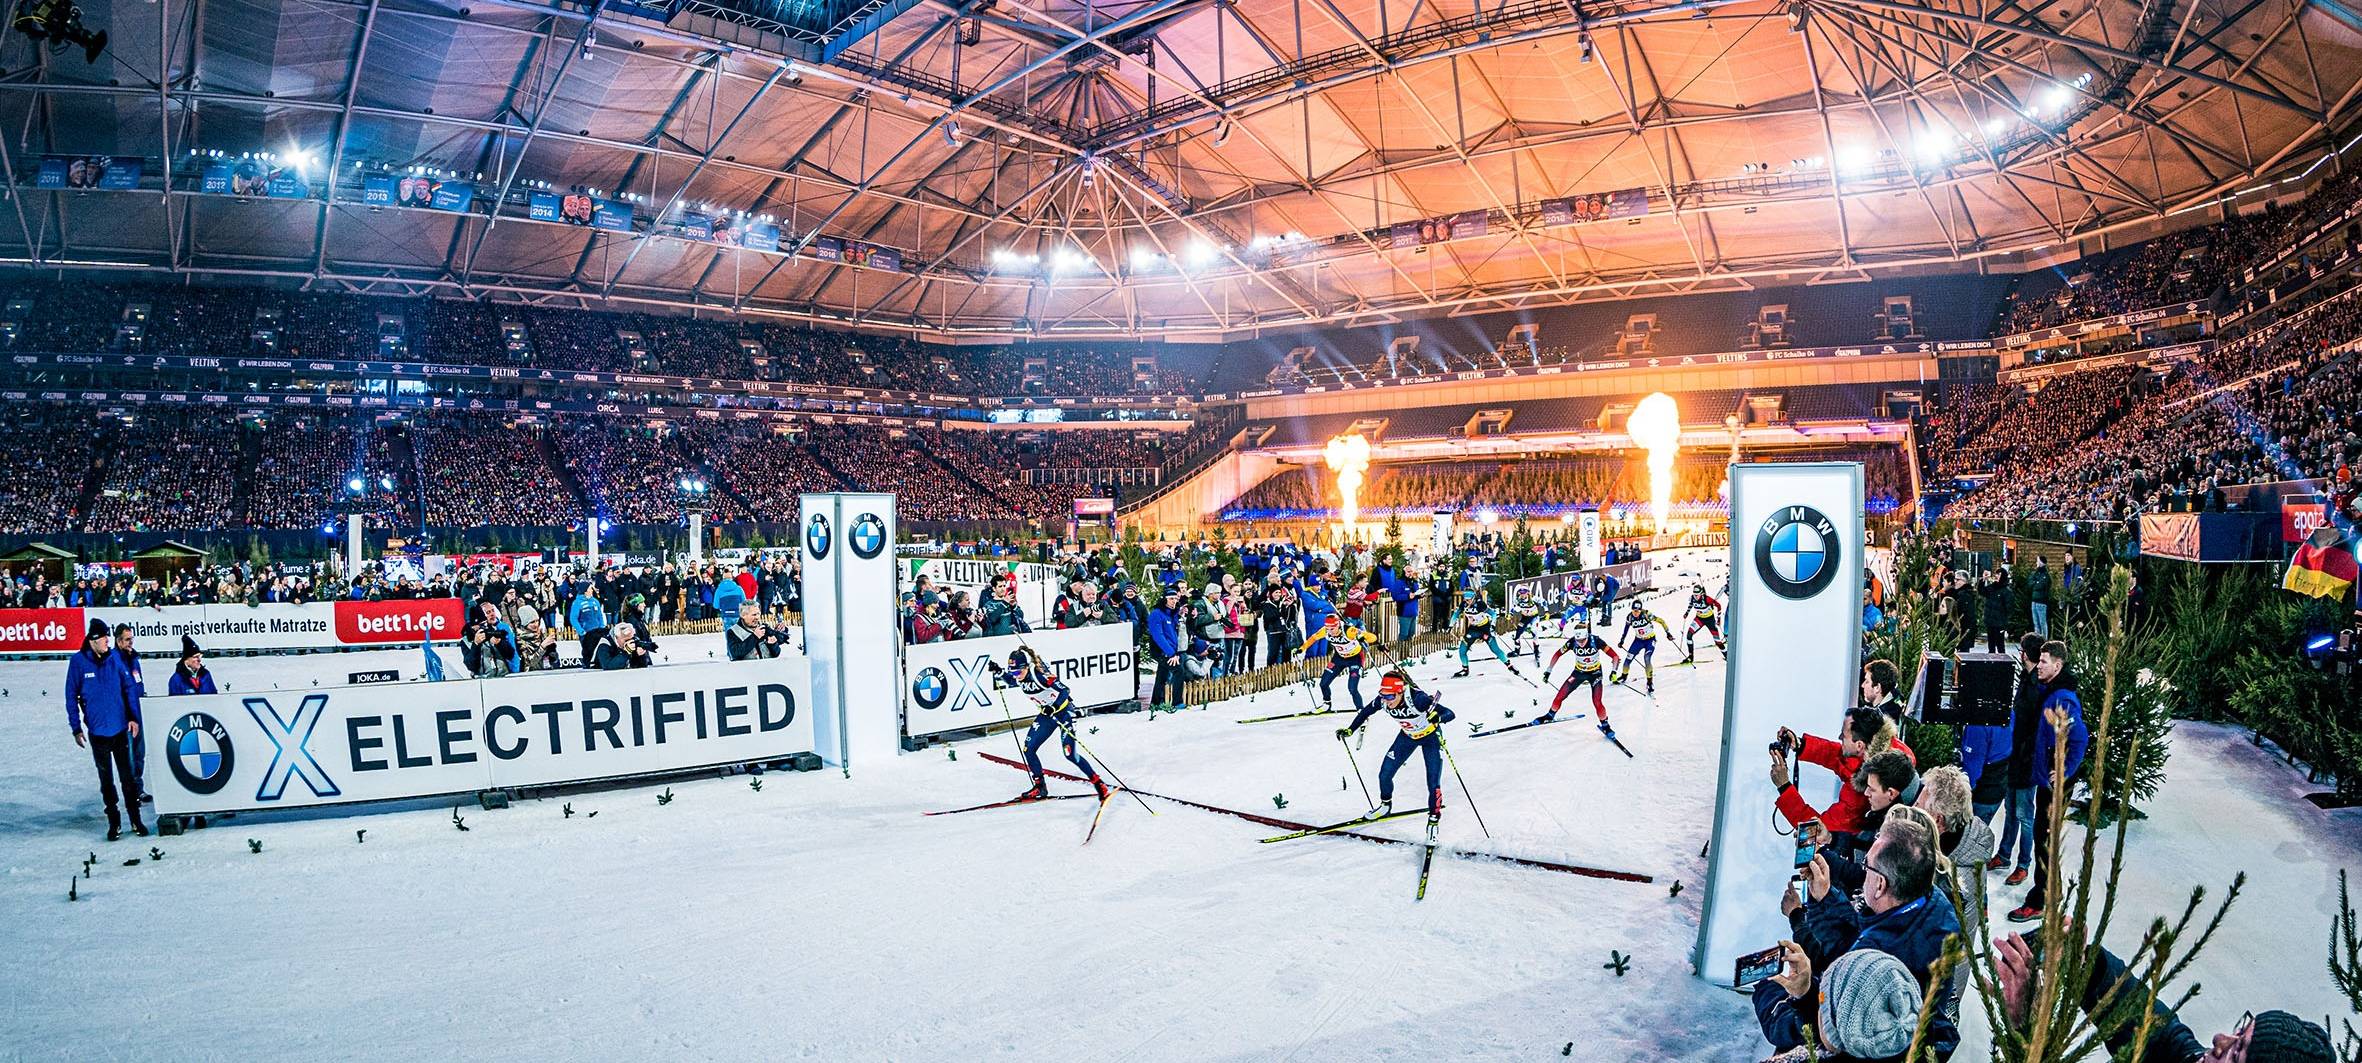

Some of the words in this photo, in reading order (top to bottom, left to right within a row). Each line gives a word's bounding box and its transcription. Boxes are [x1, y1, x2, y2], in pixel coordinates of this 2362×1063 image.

[367, 192, 388, 201] 2013
[533, 208, 553, 217] 2014
[2127, 315, 2135, 323] FC
[2136, 312, 2158, 321] Schalke
[2158, 310, 2166, 318] 04
[2005, 334, 2031, 347] VELTINS
[190, 357, 220, 368] VELTINS
[1716, 353, 1748, 363] VELTINS
[258, 360, 276, 368] LEBEN
[490, 368, 520, 377] VELTINS
[1457, 371, 1485, 381] VELTINS
[742, 382, 770, 391] VELTINS
[978, 397, 1004, 405] VELTINS
[597, 404, 620, 413] ORCA
[851, 513, 883, 528] BMW
[1762, 506, 1833, 537] BMW
[1690, 532, 1727, 546] VELTINS
[555, 565, 563, 576] 7
[565, 565, 572, 576] 8
[943, 561, 1000, 584] VELTINS
[172, 620, 205, 636] meist
[207, 618, 266, 634] verkaufte
[270, 618, 327, 633] Matratze
[358, 611, 446, 633] bett1.de
[1575, 648, 1597, 656] JOKA
[560, 657, 583, 667] JOKA
[916, 669, 945, 683] BMW
[948, 655, 992, 711] X
[171, 714, 227, 742] BMW
[242, 694, 341, 801] X
[346, 683, 796, 772] ELECTRIFIED
